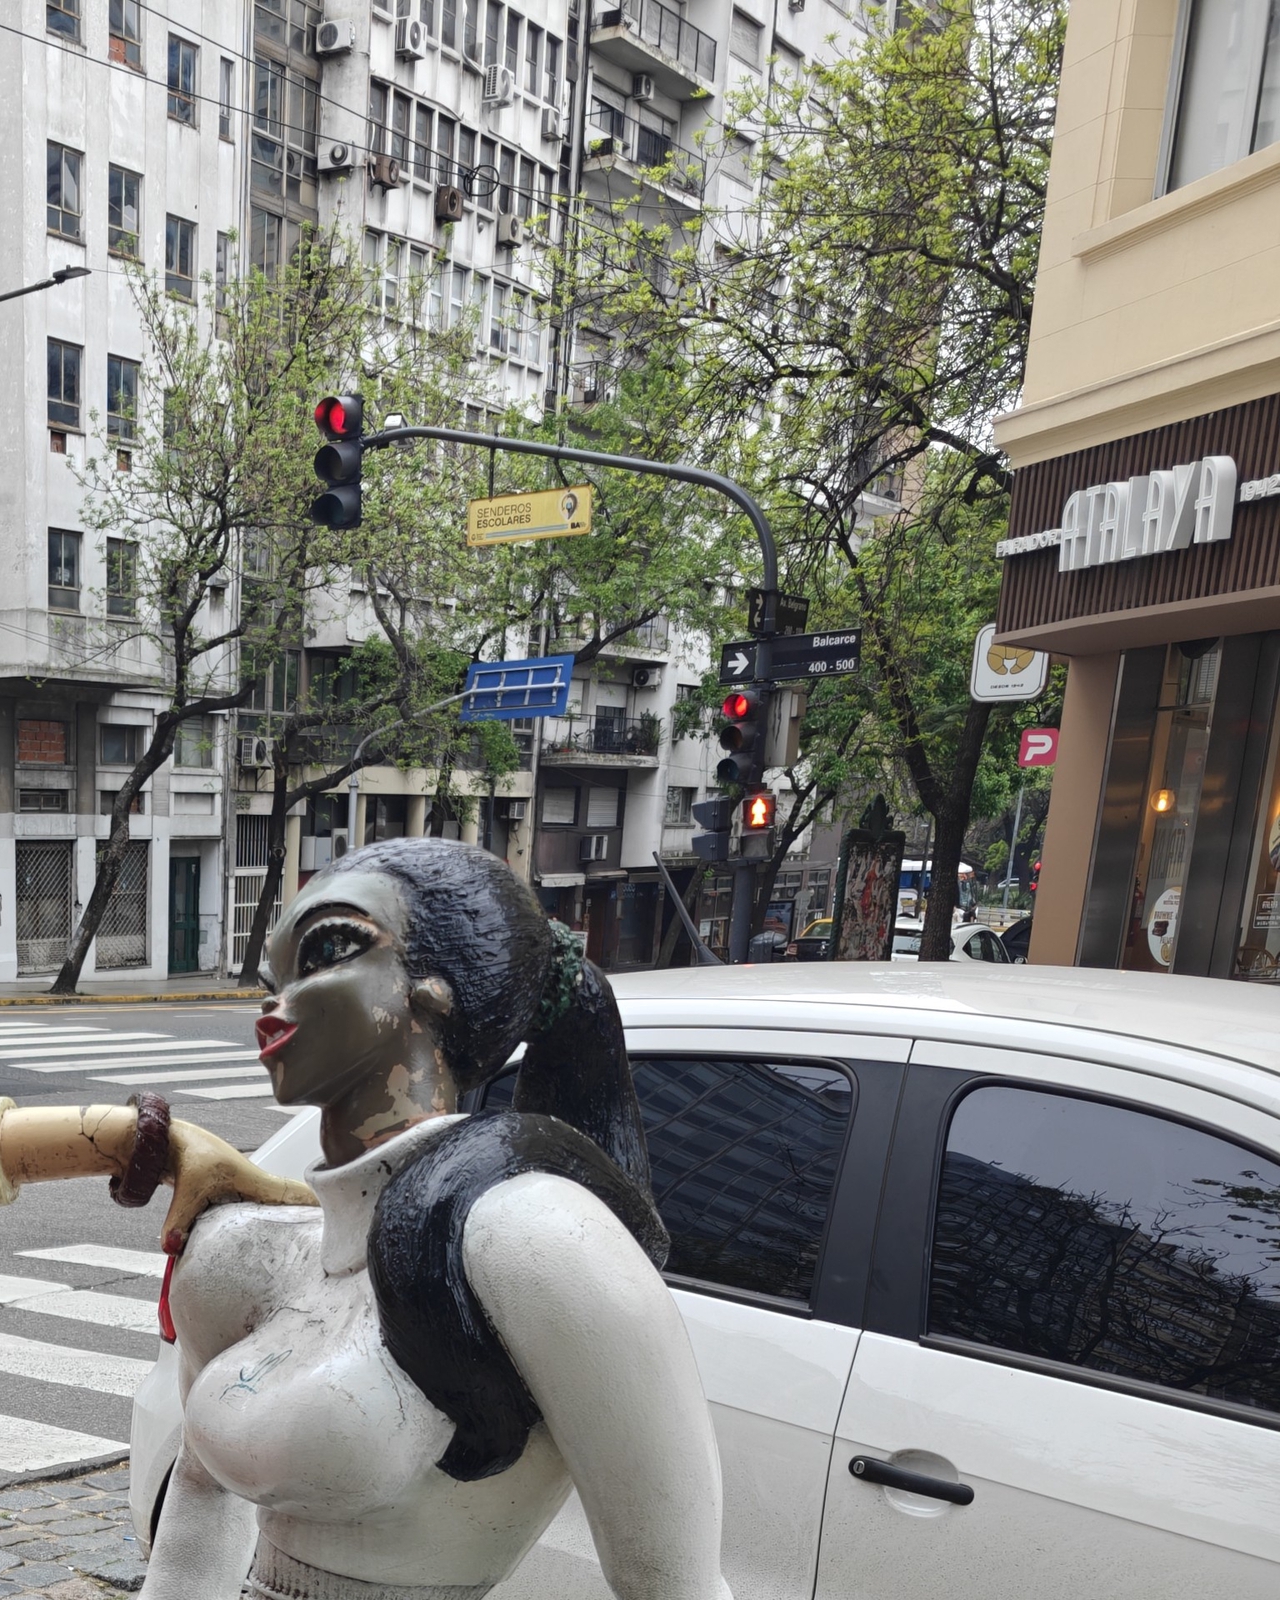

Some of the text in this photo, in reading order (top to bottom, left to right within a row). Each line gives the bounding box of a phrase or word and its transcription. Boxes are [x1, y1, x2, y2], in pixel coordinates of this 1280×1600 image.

[477, 502, 532, 519] SENDEROS
[996, 455, 1280, 572] PARADOR ATALAYA 1942
[476, 514, 531, 529] ESCOLARES
[812, 634, 857, 648] Balcarce
[808, 661, 827, 673] 400
[836, 659, 855, 671] 500
[1023, 734, 1053, 762] P
